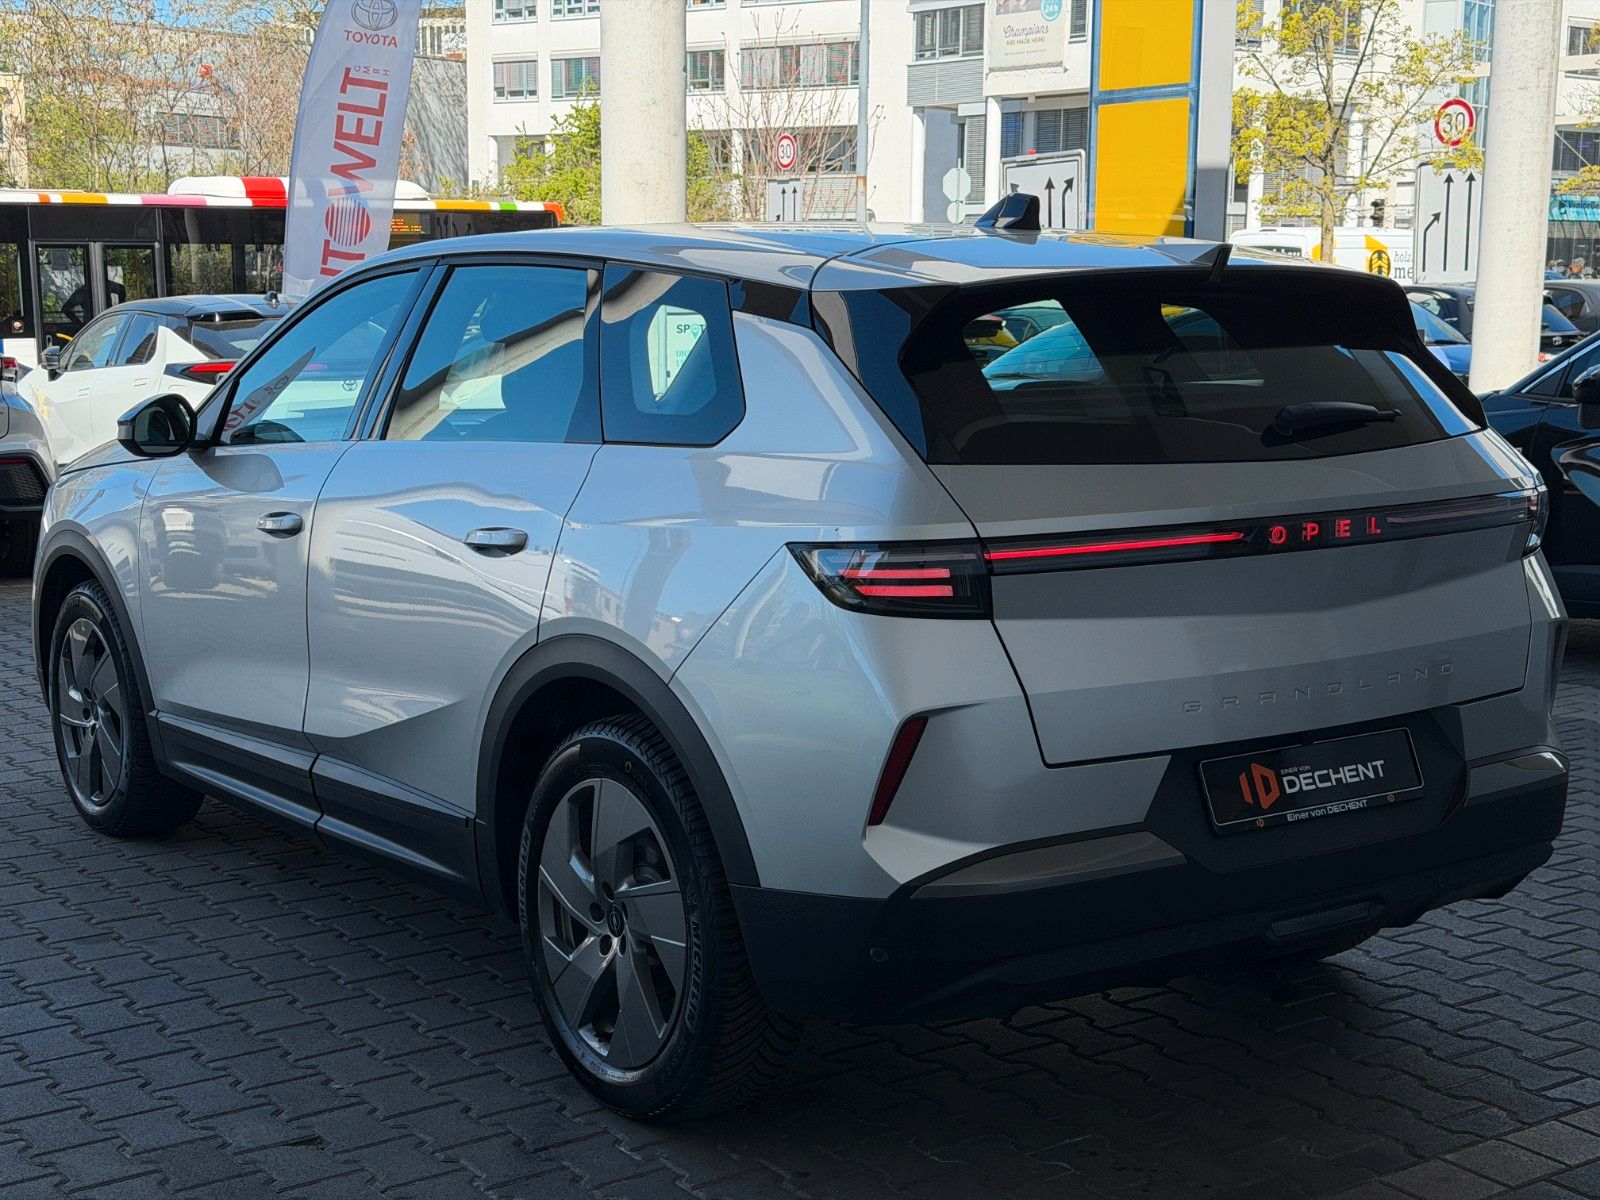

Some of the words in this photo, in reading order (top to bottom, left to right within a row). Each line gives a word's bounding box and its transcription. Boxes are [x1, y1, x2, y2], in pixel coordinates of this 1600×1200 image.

[344, 29, 398, 48] TOYOTA
[1003, 24, 1049, 38] Champions
[1442, 112, 1466, 134] 30
[780, 143, 792, 160] 30
[1268, 515, 1382, 545] OPEL
[1181, 662, 1456, 714] GRANDLAND
[1280, 766, 1298, 775] EINER
[1298, 764, 1311, 772] VON
[1282, 759, 1385, 795] DECHENT
[1286, 810, 1310, 822] Einer
[1310, 807, 1327, 818] von
[1327, 799, 1368, 815] DECHENT
